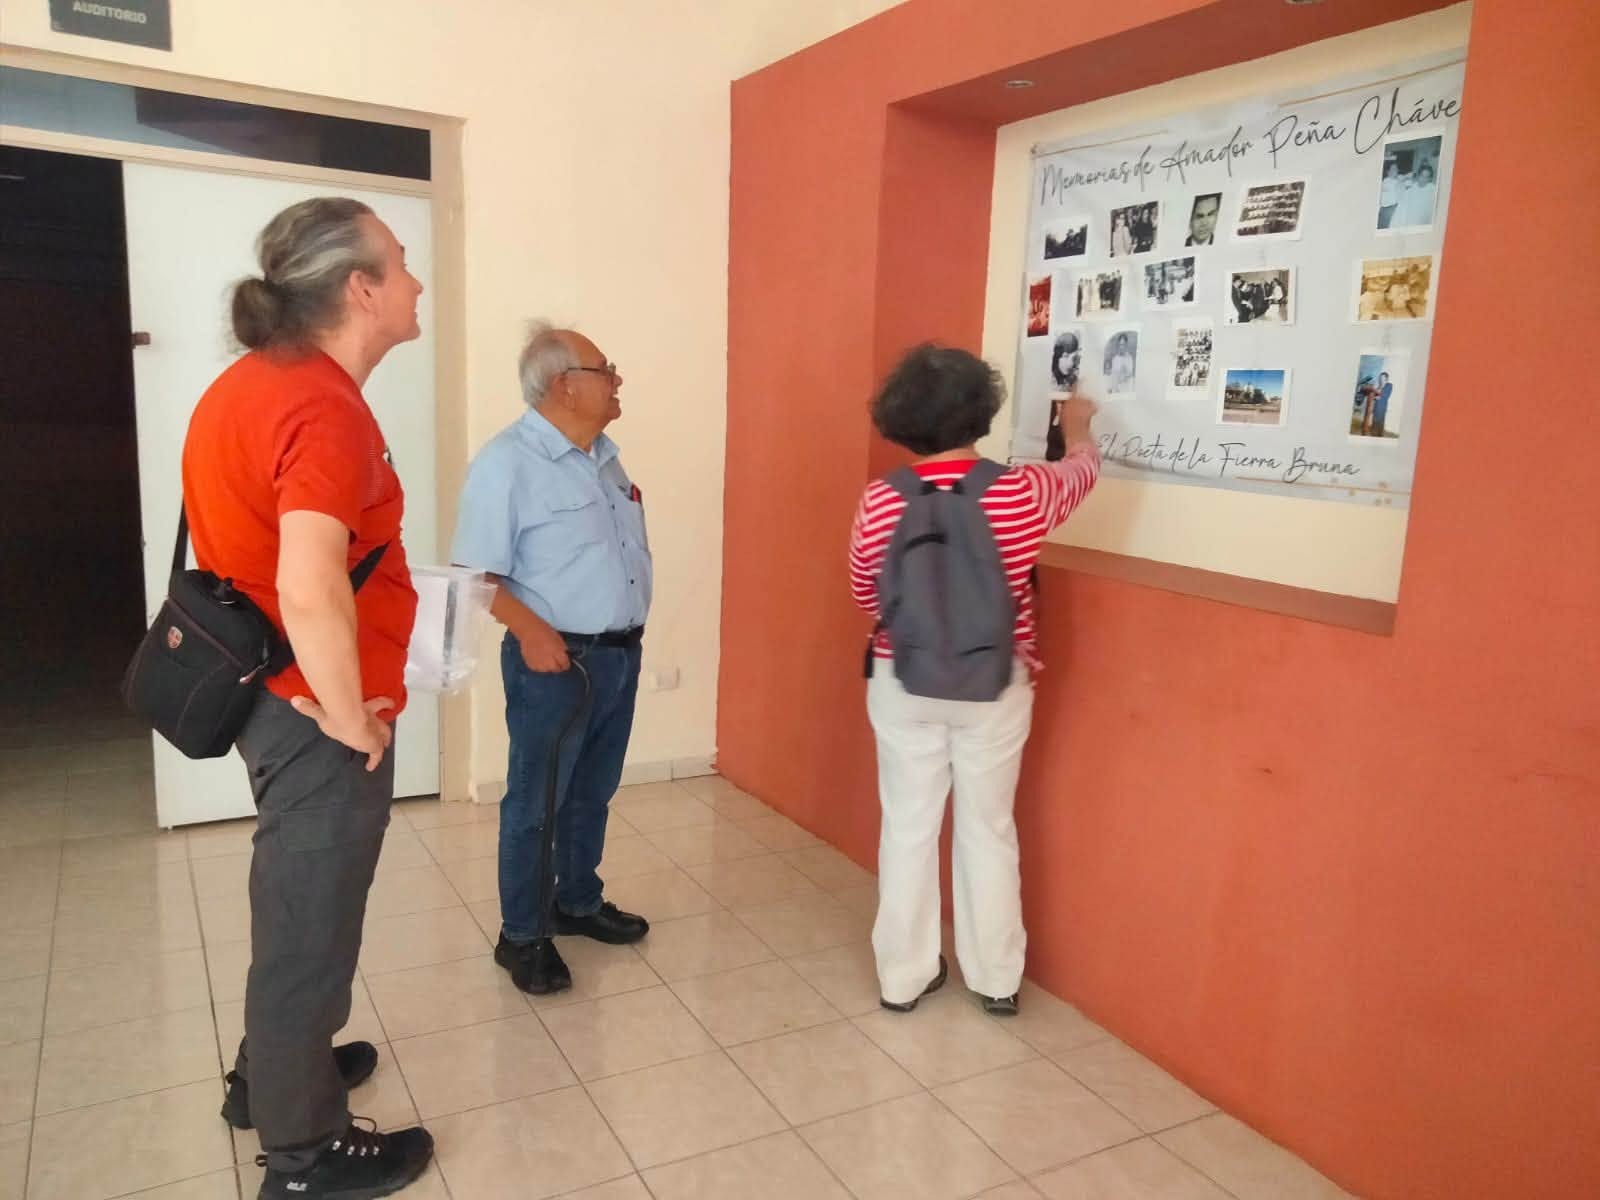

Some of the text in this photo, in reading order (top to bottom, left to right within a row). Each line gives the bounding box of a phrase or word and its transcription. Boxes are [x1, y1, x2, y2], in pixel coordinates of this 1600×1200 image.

[72, 1, 147, 24] AUDITORIO
[1159, 125, 1253, 184] Amador
[1263, 115, 1346, 168] Peña
[1354, 87, 1462, 155] Cháve
